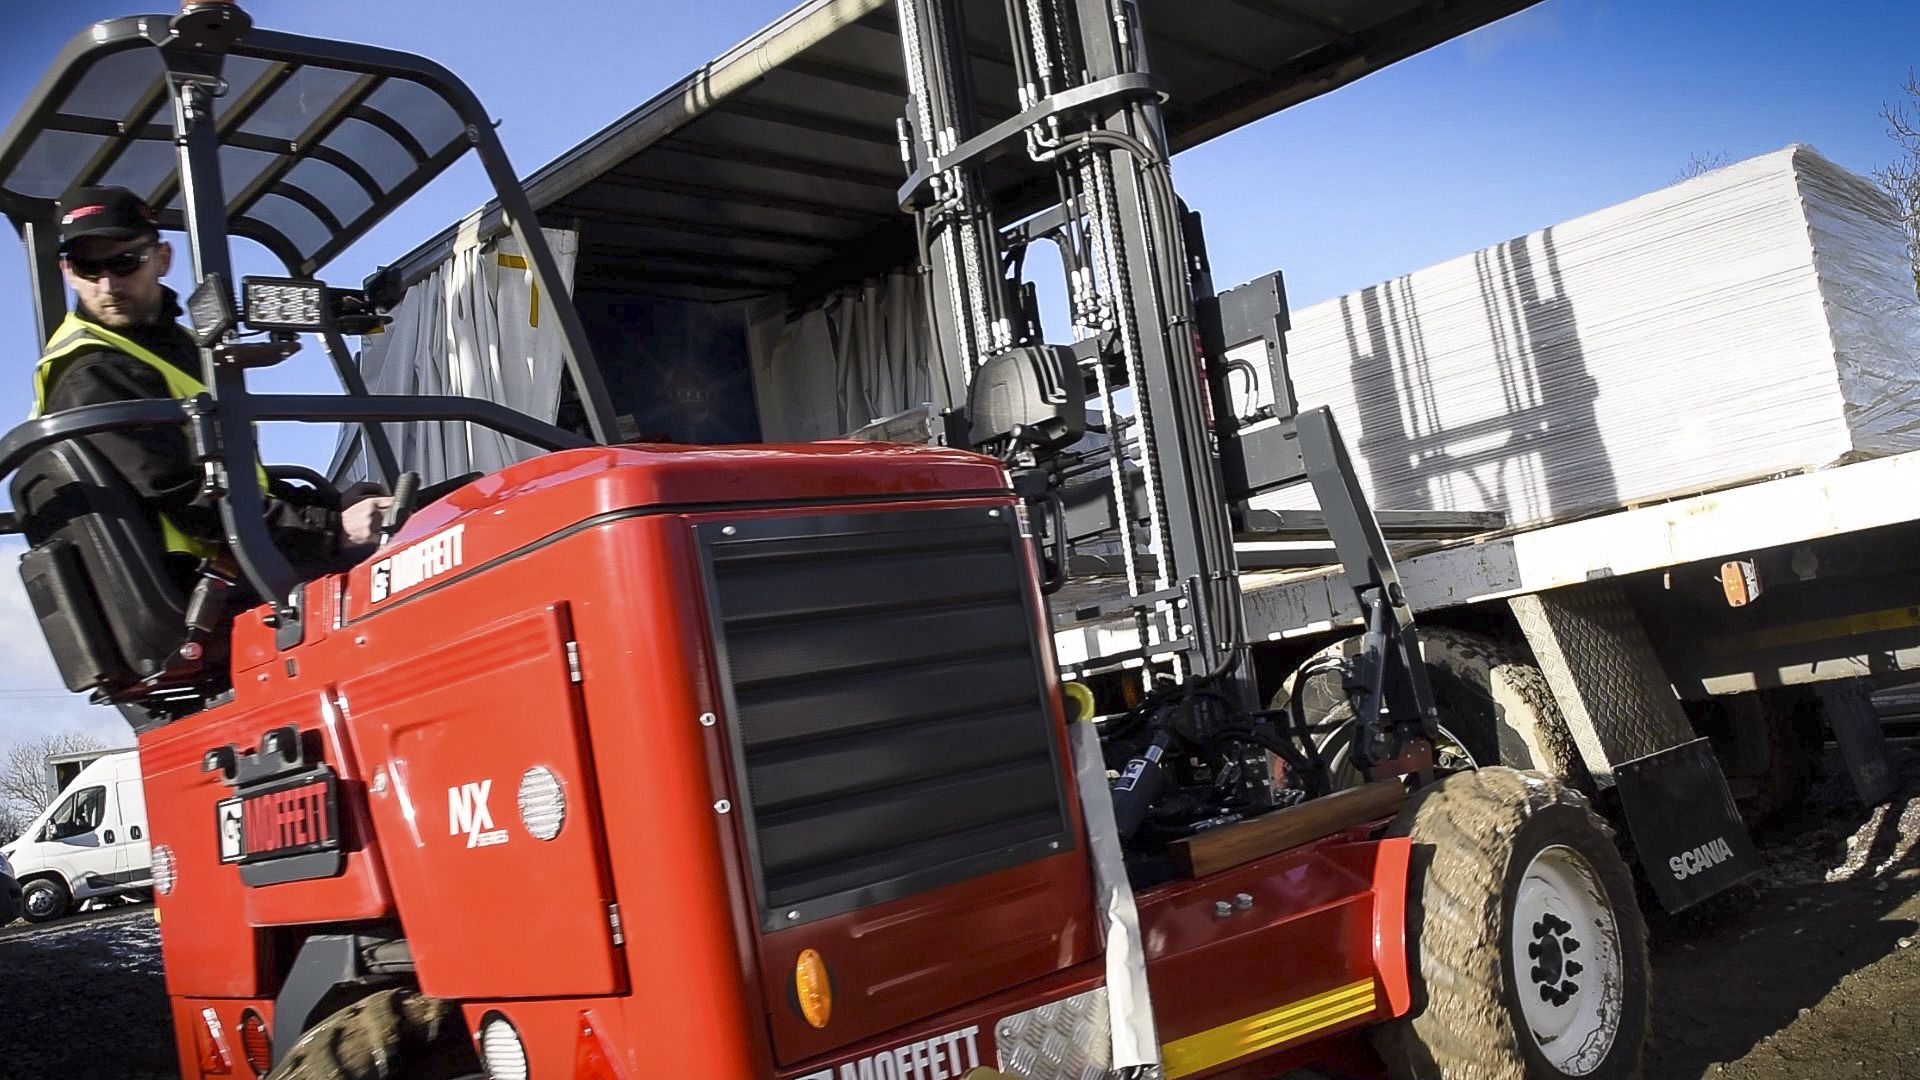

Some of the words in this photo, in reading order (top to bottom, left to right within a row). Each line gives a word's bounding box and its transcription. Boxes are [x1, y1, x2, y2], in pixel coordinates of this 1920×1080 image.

[244, 781, 329, 854] MOFFETT
[447, 779, 495, 848] NX
[1669, 837, 1734, 880] SCANIA
